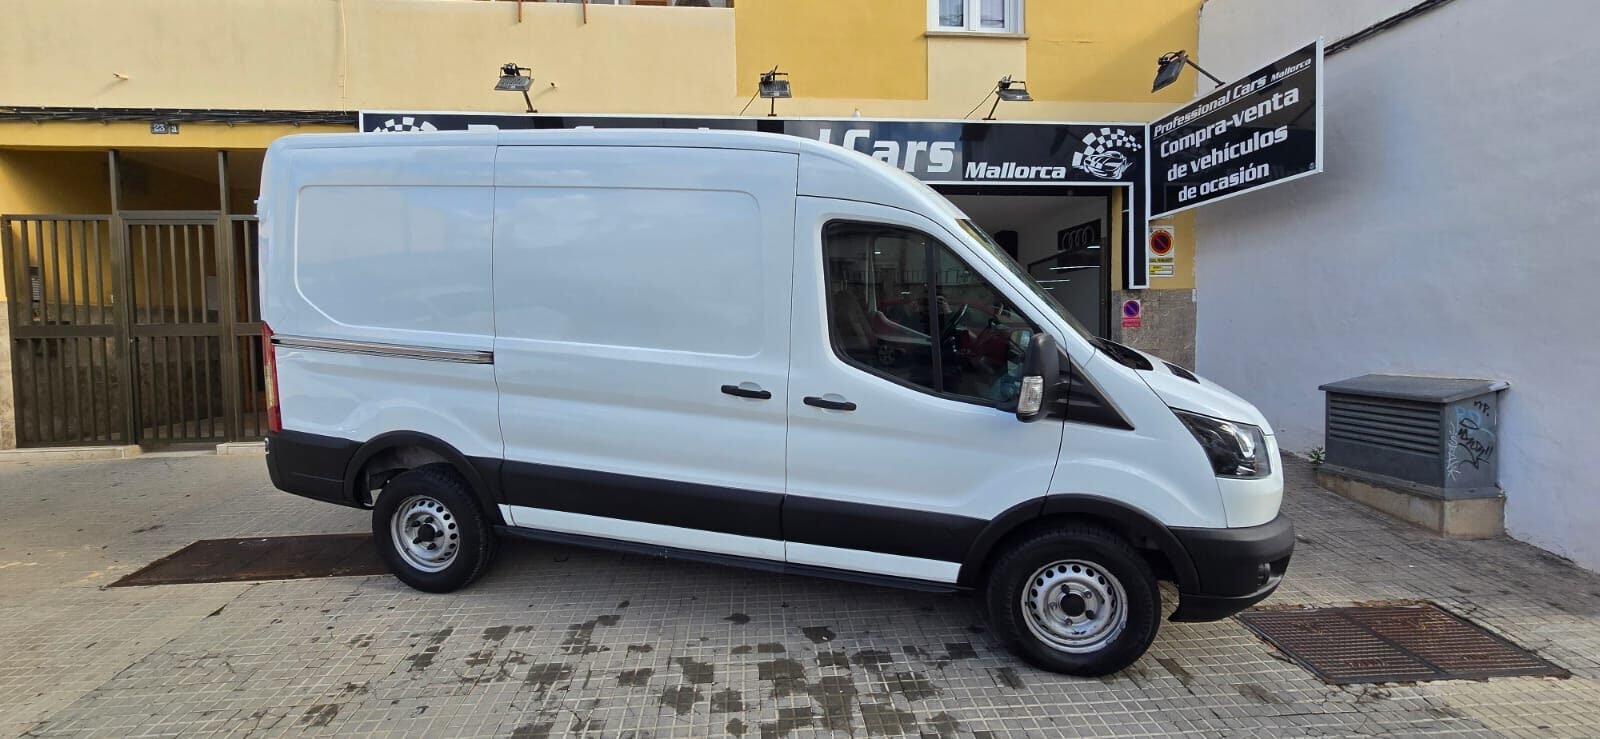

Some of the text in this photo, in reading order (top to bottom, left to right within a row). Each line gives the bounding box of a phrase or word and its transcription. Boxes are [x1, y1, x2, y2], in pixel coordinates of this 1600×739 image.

[1153, 58, 1312, 137] Professional Cars Mallorca
[1160, 87, 1300, 158] Compra-venta
[964, 161, 1067, 180] Mallorca
[1167, 125, 1288, 182] de vehículos
[1178, 162, 1270, 202] de ocasión
